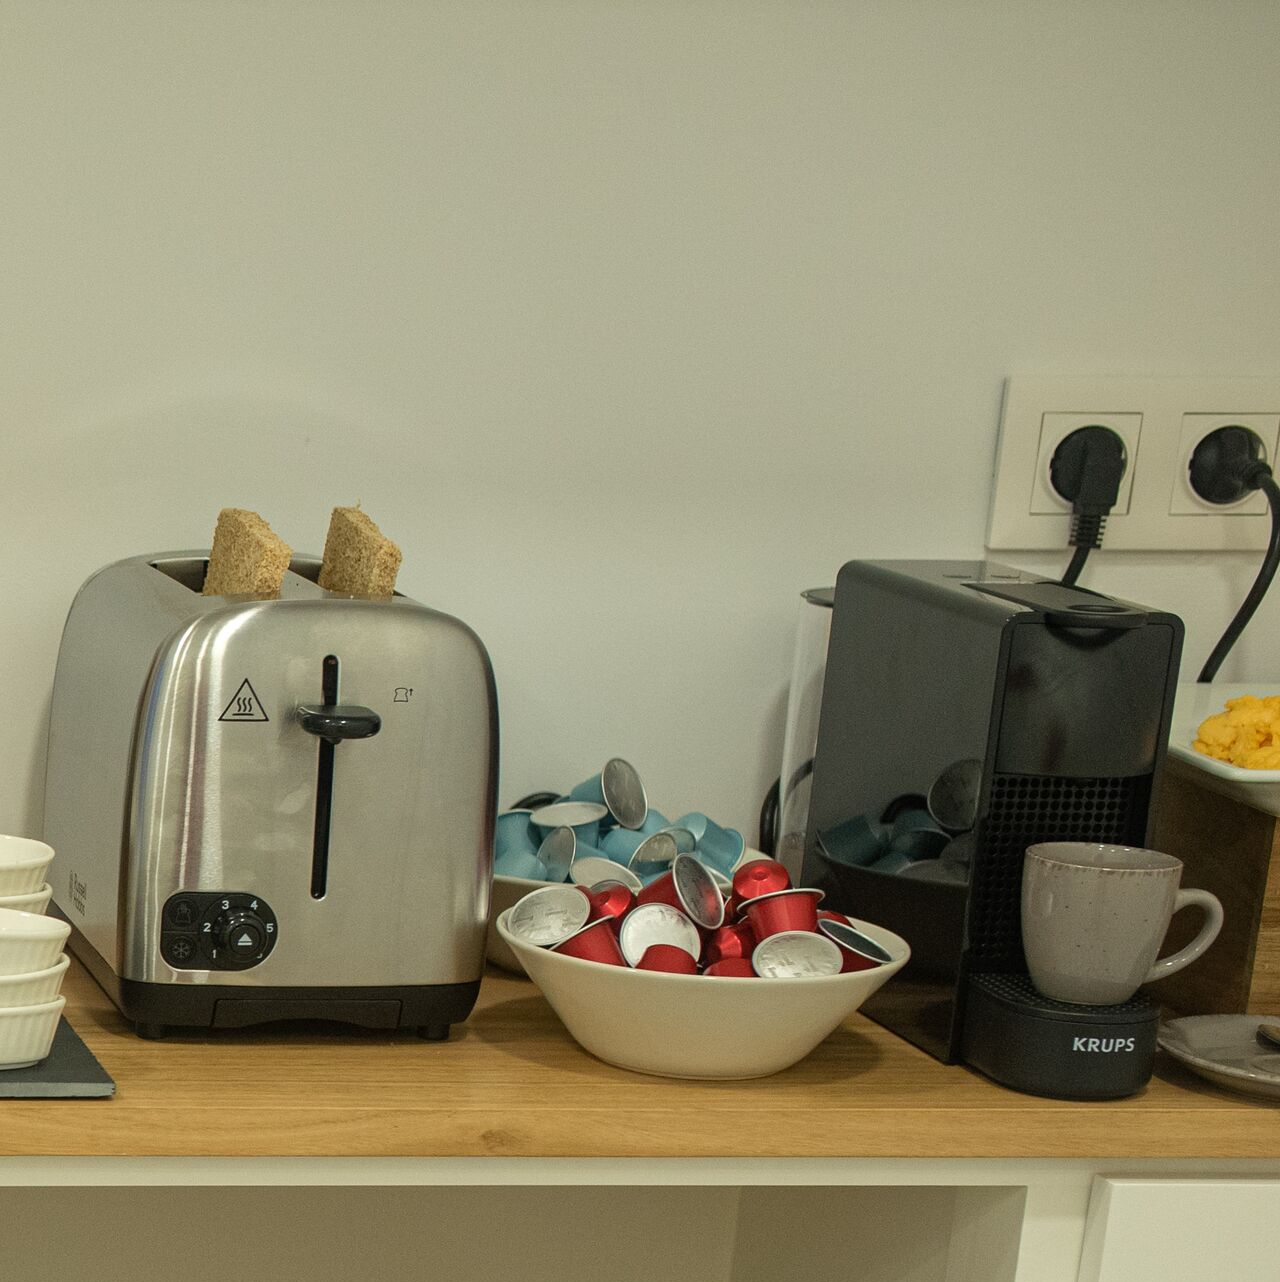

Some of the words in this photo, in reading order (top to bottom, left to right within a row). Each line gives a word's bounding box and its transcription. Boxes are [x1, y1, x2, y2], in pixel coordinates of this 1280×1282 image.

[222, 900, 230, 910] 3
[250, 900, 258, 910] 4
[203, 922, 212, 932] 2
[266, 923, 274, 933] 5
[212, 949, 217, 959] 1
[1072, 1037, 1136, 1053] KRUPS
